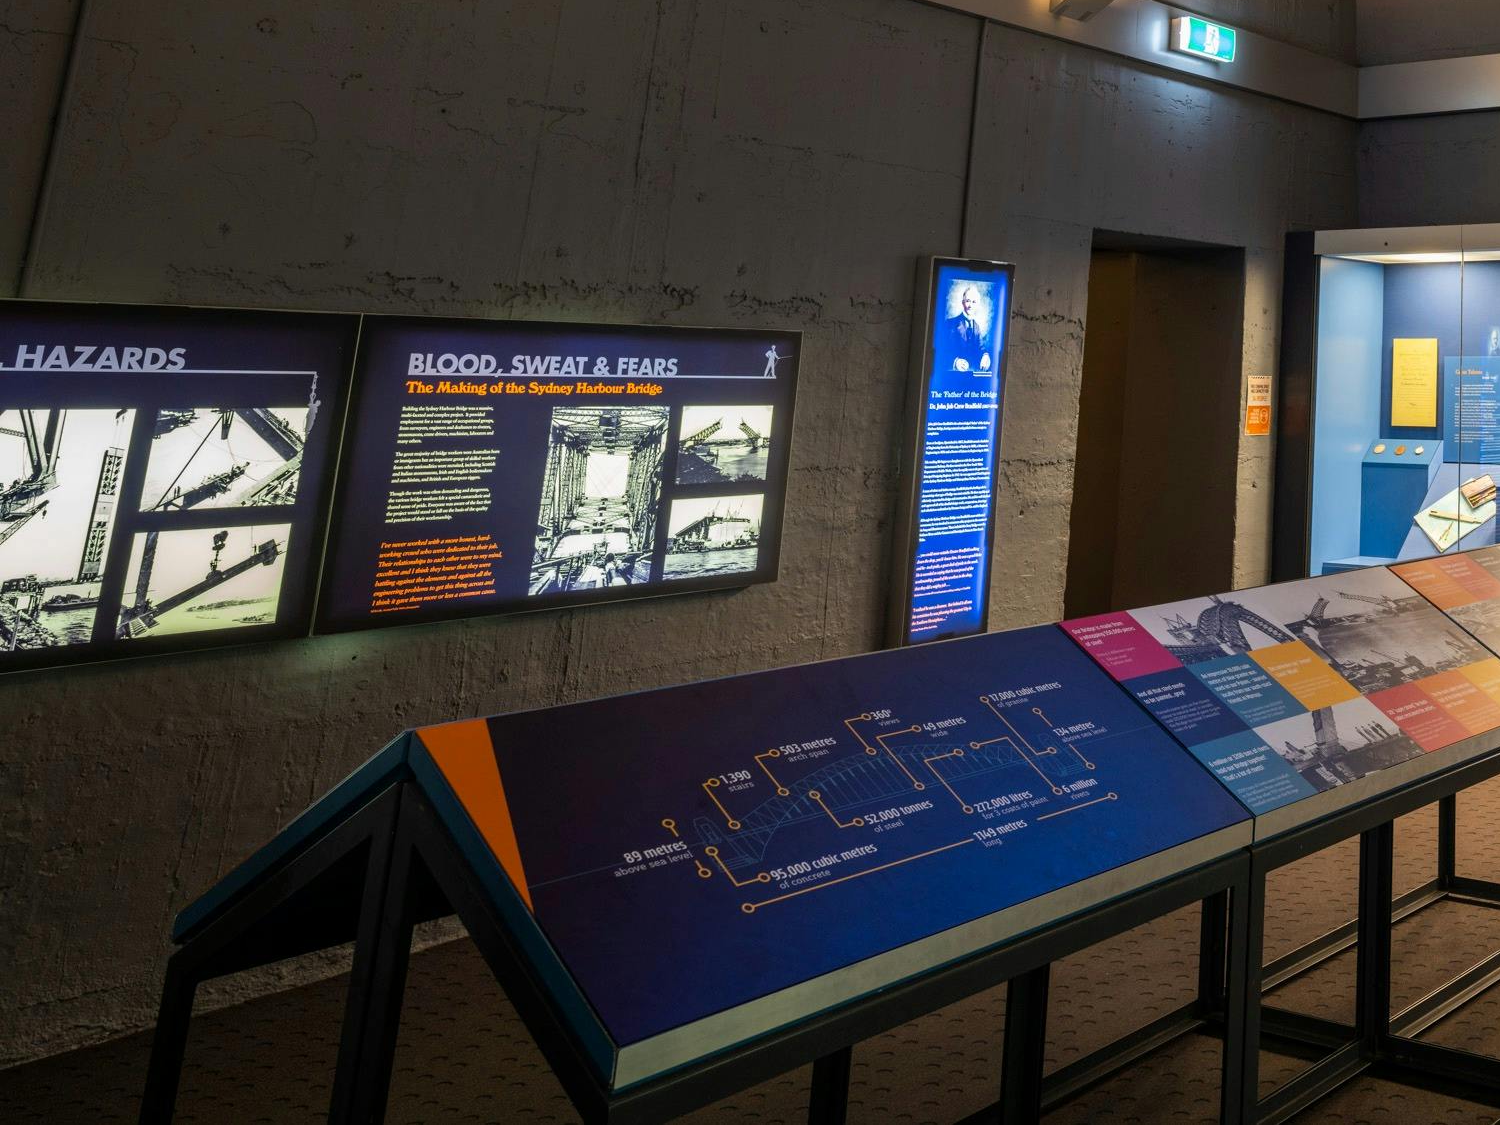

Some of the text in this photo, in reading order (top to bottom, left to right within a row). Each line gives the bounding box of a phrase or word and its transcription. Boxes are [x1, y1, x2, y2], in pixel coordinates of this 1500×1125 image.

[16, 344, 187, 371] HAZARDS
[407, 352, 679, 377] BLOOD, SWEAT & FEARS
[406, 381, 663, 395] The Making of the Sydney Harbour Bridge
[980, 391, 998, 399] Bridge
[988, 681, 1062, 702] 17,000 cubic metres
[879, 718, 900, 726] views
[923, 715, 967, 732] 49 metres
[1053, 721, 1095, 737] 134 metres
[930, 730, 948, 738] wide
[1062, 726, 1108, 743] above sea level
[779, 736, 837, 755] 503 metres
[787, 748, 830, 763] arch span
[720, 770, 752, 786] 1,390
[1061, 778, 1098, 793] 6 million
[728, 781, 755, 793] stairs
[1070, 790, 1090, 800] rivets
[973, 790, 1033, 813] 272,000 litres
[982, 796, 1049, 820] for 3 coats of paint
[864, 799, 934, 825] 52,000 tonnes
[874, 820, 904, 834] of steel
[973, 819, 1029, 841] 1149 metres
[982, 838, 1003, 848] long
[623, 840, 688, 865] 89 metres
[614, 850, 694, 878] above sea level
[770, 842, 878, 882] 95,000 cubic metres
[779, 868, 832, 891] of concrete
